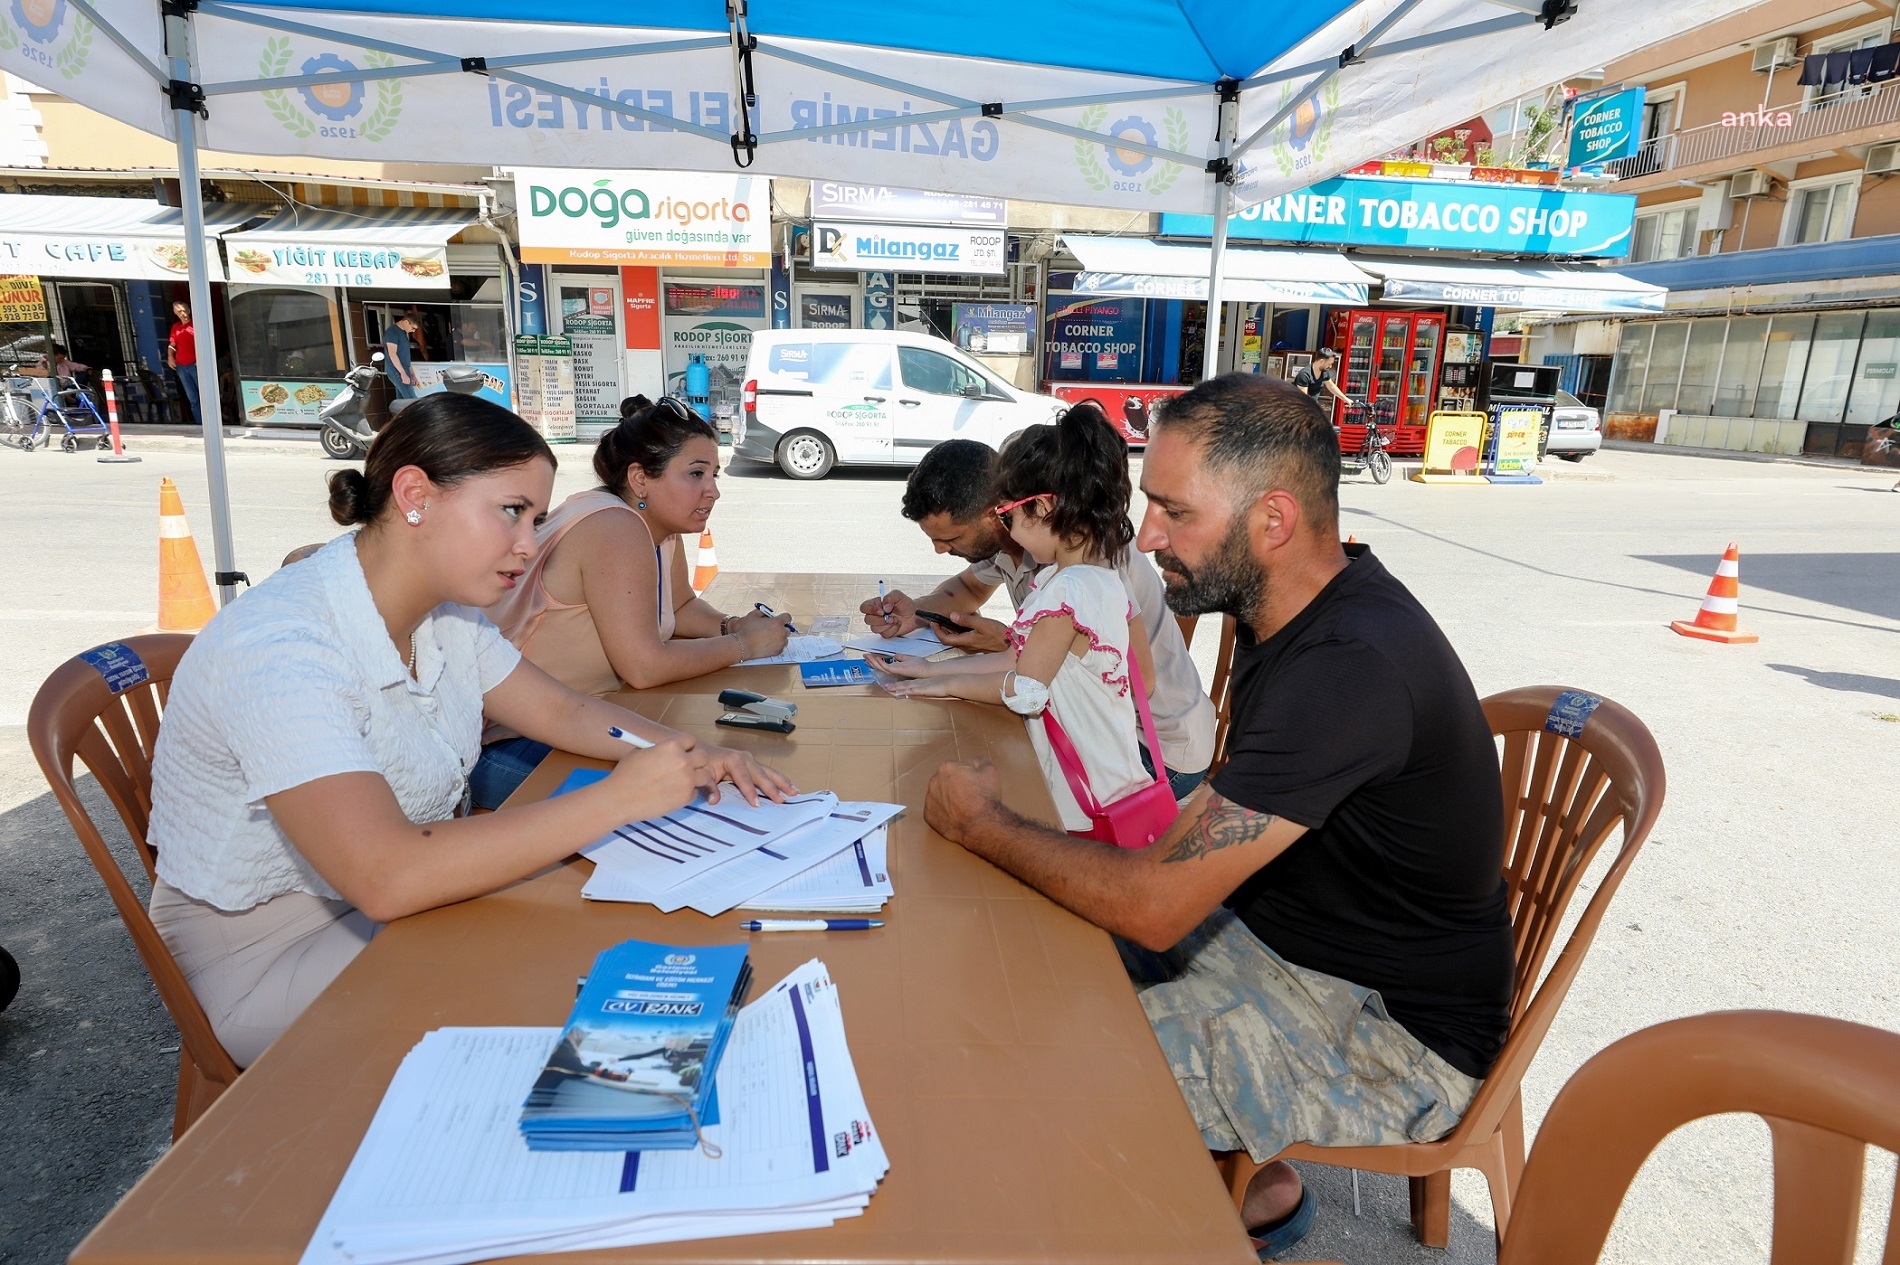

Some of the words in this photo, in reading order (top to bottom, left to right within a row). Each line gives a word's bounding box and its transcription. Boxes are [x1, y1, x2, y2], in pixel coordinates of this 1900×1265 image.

[1584, 109, 1622, 127] CORNER
[1580, 121, 1623, 141] TOBACCO
[1586, 137, 1612, 152] SHOP
[822, 183, 893, 203] SIRMA
[654, 196, 751, 226] sigorta
[1359, 198, 1498, 234] TOBACCO
[1508, 207, 1588, 238] SHOP
[625, 230, 663, 244] güven
[666, 229, 729, 245] doğasında
[732, 231, 752, 243] var
[970, 236, 1001, 246] RODOP
[45, 243, 127, 262] CAFE
[857, 234, 960, 261] Milangaz
[273, 246, 327, 267] YİĞİT
[334, 249, 401, 270] KEBAP
[569, 250, 600, 260] Rodop
[602, 251, 636, 261] Sigorta
[638, 251, 673, 261] Aracılık
[675, 252, 721, 262] Hizmetleri
[306, 272, 329, 284] 281
[336, 273, 350, 285] 11
[356, 274, 373, 286] 05
[1134, 281, 1197, 296] CORNER
[1442, 287, 1498, 301] CORNER
[3, 304, 18, 313] 593
[20, 303, 45, 312] 0208
[809, 303, 846, 316] SIRMA
[978, 304, 1026, 321] Milangaz
[4, 312, 21, 321] 928
[22, 311, 46, 320] 7387
[674, 332, 711, 342] RODOP
[715, 329, 753, 345] SİGORT
[1065, 325, 1114, 337] CORNER
[780, 349, 806, 359] SIRMA
[1045, 341, 1101, 353] TOBACCO
[1104, 343, 1136, 354] SHOP
[827, 411, 853, 419] RODOP
[644, 1003, 698, 1015] BANK
